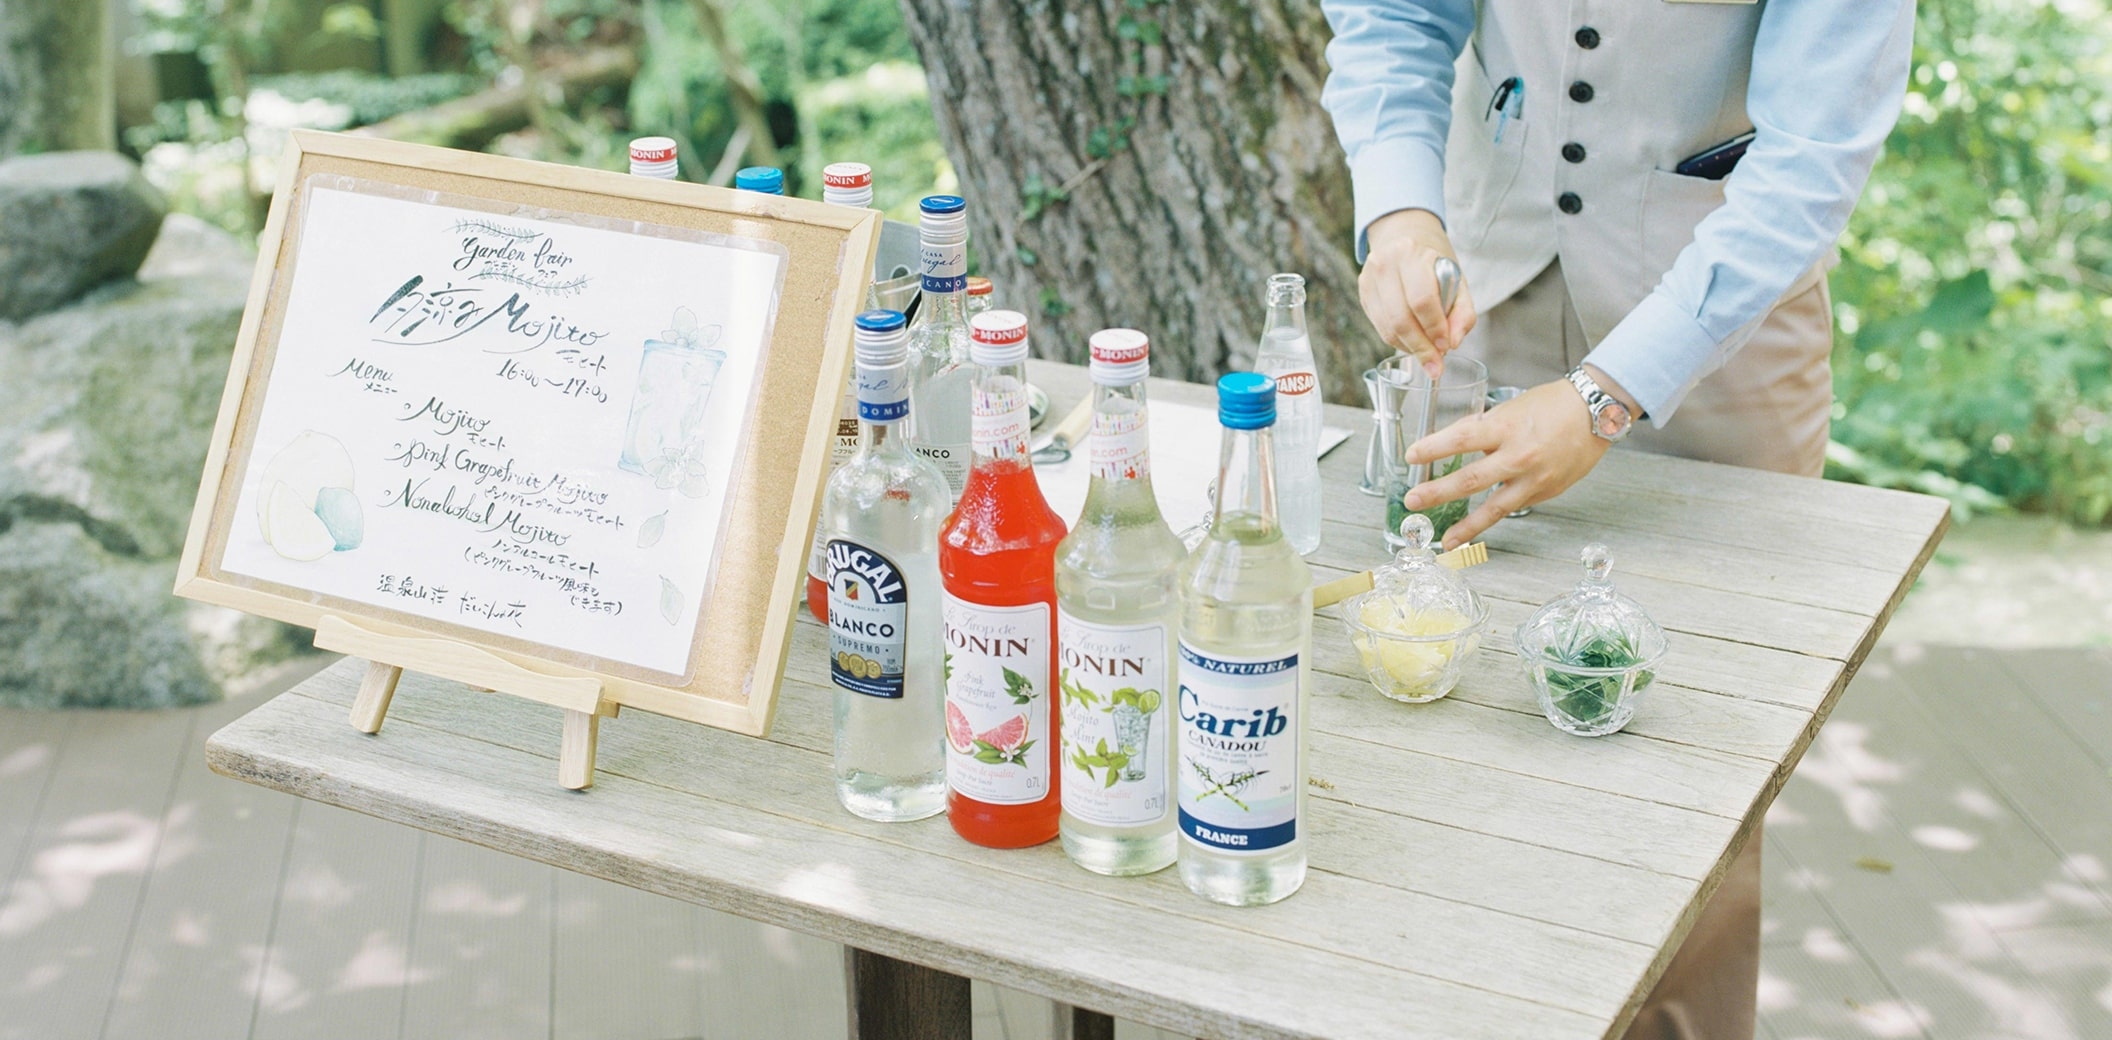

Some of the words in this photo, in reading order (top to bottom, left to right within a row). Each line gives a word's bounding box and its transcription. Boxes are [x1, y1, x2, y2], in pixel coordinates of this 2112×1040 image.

[484, 292, 610, 354] Mojito
[332, 357, 394, 381] Menu
[405, 396, 491, 436] Mojito
[490, 509, 572, 546] Mojito
[838, 635, 881, 655] SUPREMO
[1060, 641, 1145, 677] ONIN
[1203, 658, 1288, 675] NATUREL
[1178, 683, 1288, 738] Carib
[1188, 729, 1267, 752] CANADOU
[1194, 824, 1249, 846] FRANCE
